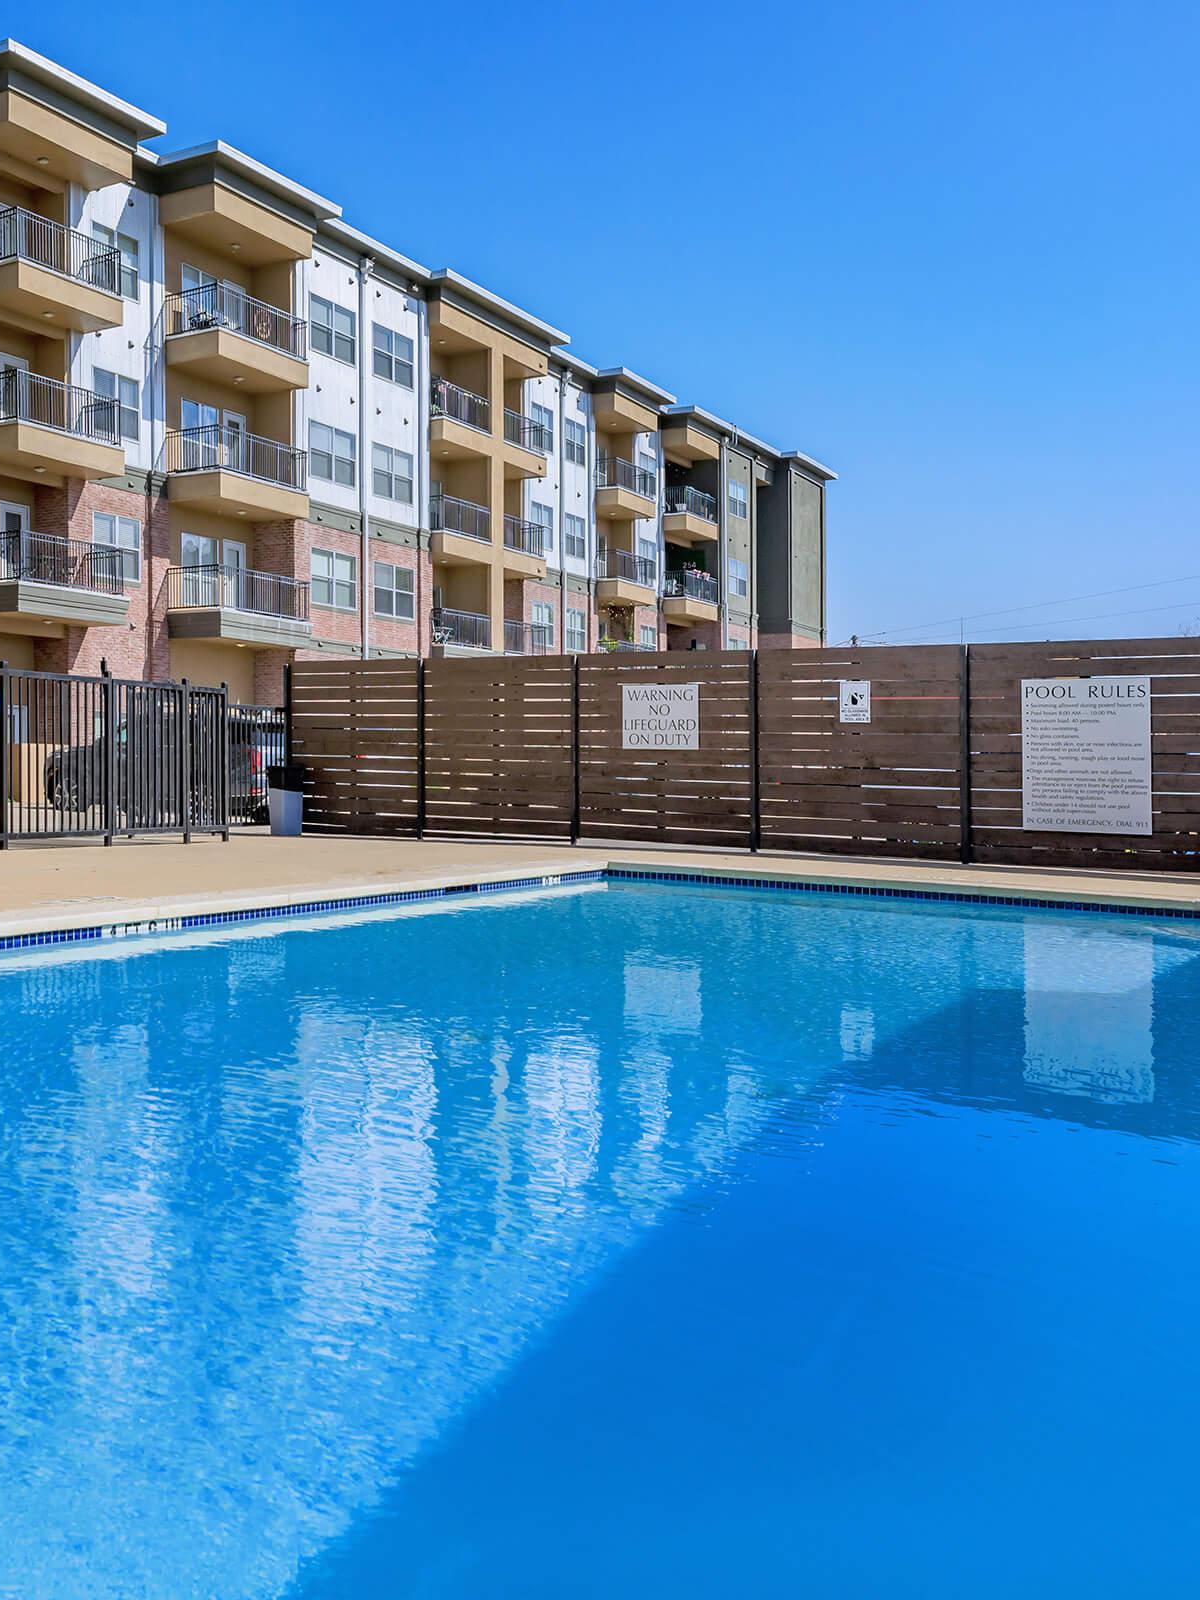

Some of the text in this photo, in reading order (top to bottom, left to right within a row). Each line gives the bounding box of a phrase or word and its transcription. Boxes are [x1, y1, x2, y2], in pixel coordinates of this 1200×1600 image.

[627, 689, 694, 702] WARNING
[1025, 684, 1146, 700] POOL RULES
[649, 704, 670, 716] NO
[624, 719, 696, 731] LIFEGUARD
[629, 734, 691, 745] ON DUTY
